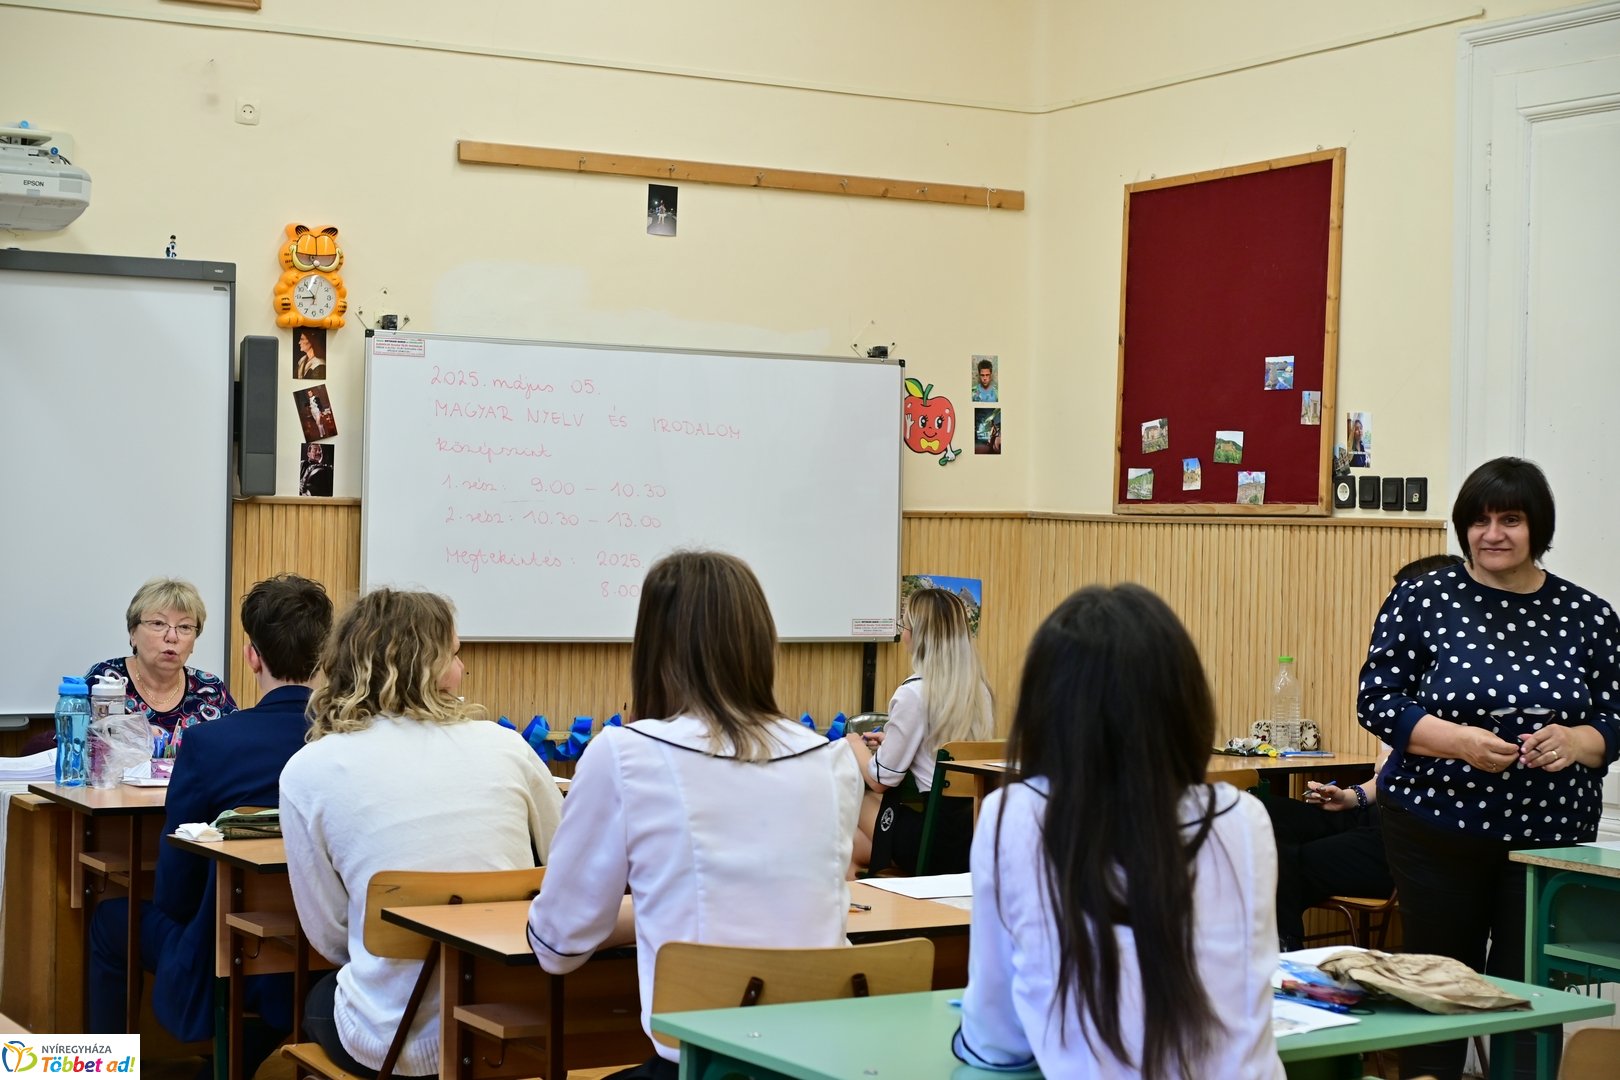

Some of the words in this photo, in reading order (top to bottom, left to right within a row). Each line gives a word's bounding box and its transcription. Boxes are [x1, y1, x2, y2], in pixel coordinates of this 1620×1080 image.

[431, 366, 486, 387] 2025.
[493, 374, 554, 399] május
[570, 379, 601, 395] 05.
[435, 400, 513, 421] MAGYAR
[527, 407, 584, 427] NYELV
[608, 405, 628, 428] ÉS
[652, 417, 740, 440] IRODALOM
[530, 477, 575, 495] 9.00
[610, 481, 666, 498] 10.30
[522, 510, 579, 526] 10.30
[607, 512, 662, 528] 13.00
[600, 580, 640, 598] 8.00
